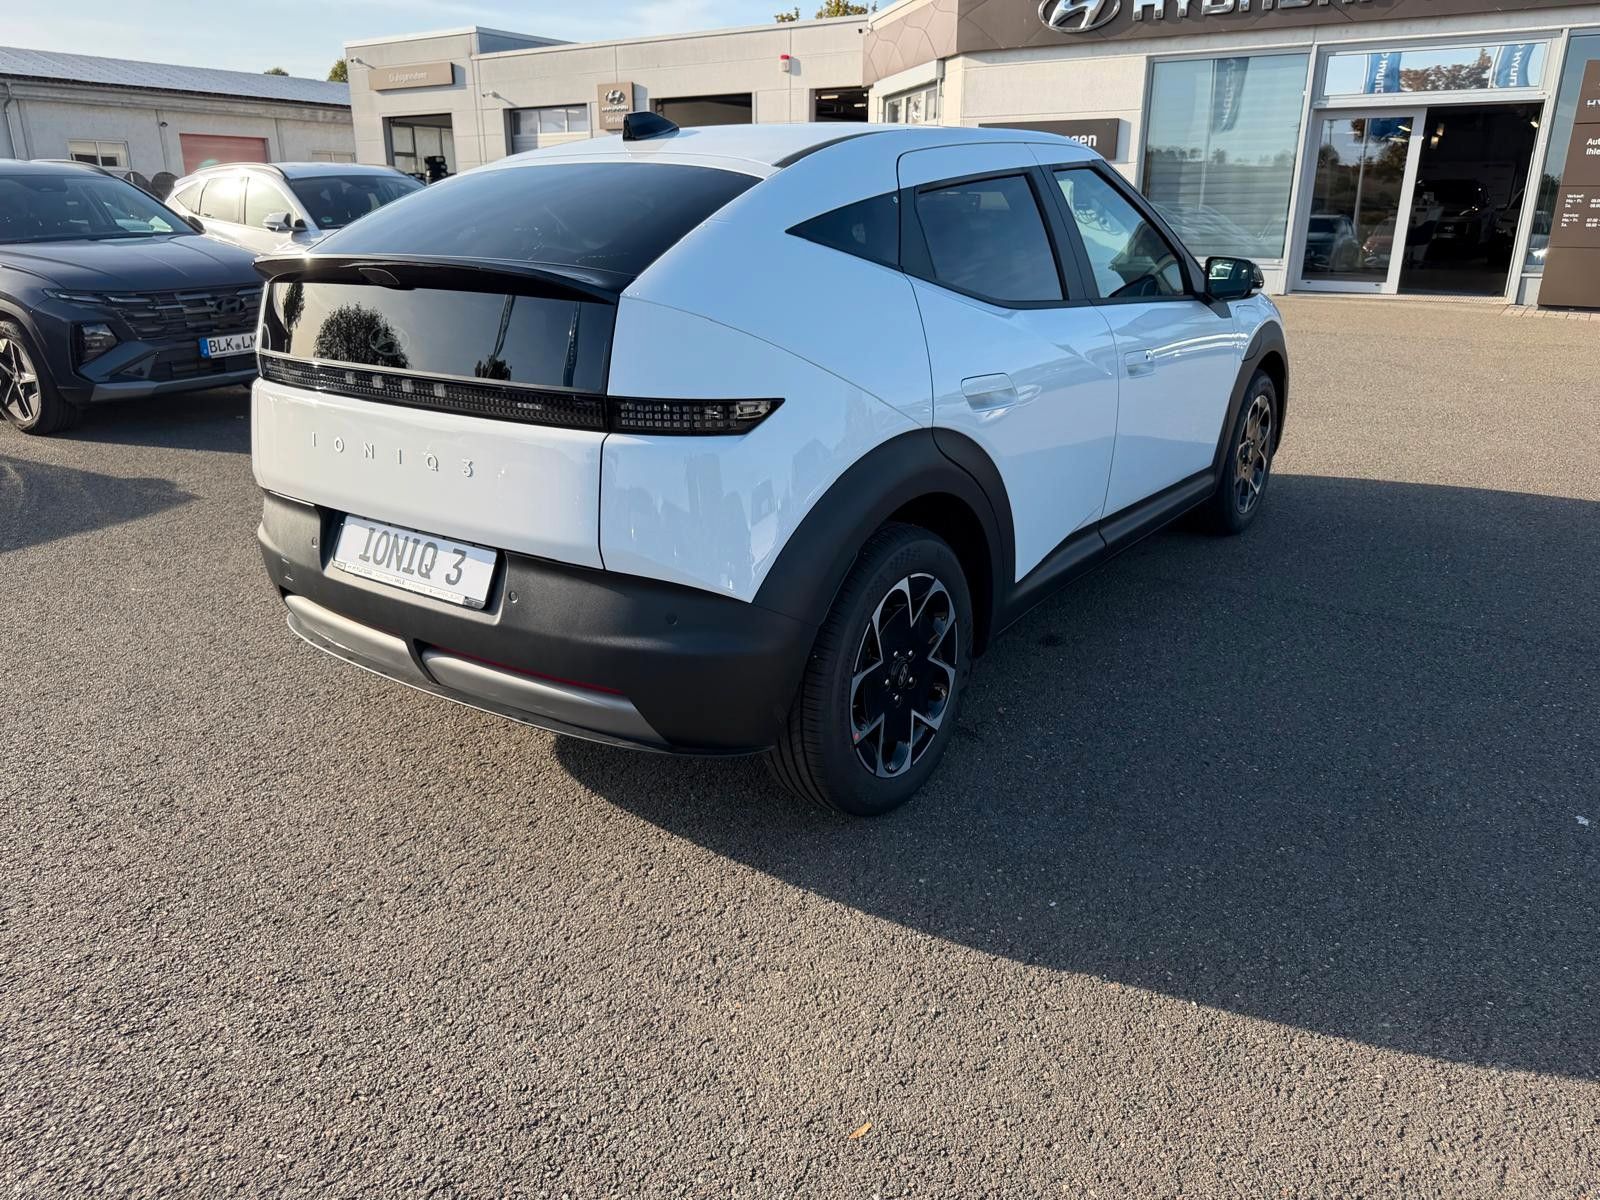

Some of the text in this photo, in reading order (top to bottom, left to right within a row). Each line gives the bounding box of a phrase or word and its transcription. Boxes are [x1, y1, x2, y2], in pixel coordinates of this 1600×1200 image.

[209, 338, 234, 353] BLK
[312, 432, 474, 478] IONIQ 3
[359, 527, 467, 586] IONIQ 3
